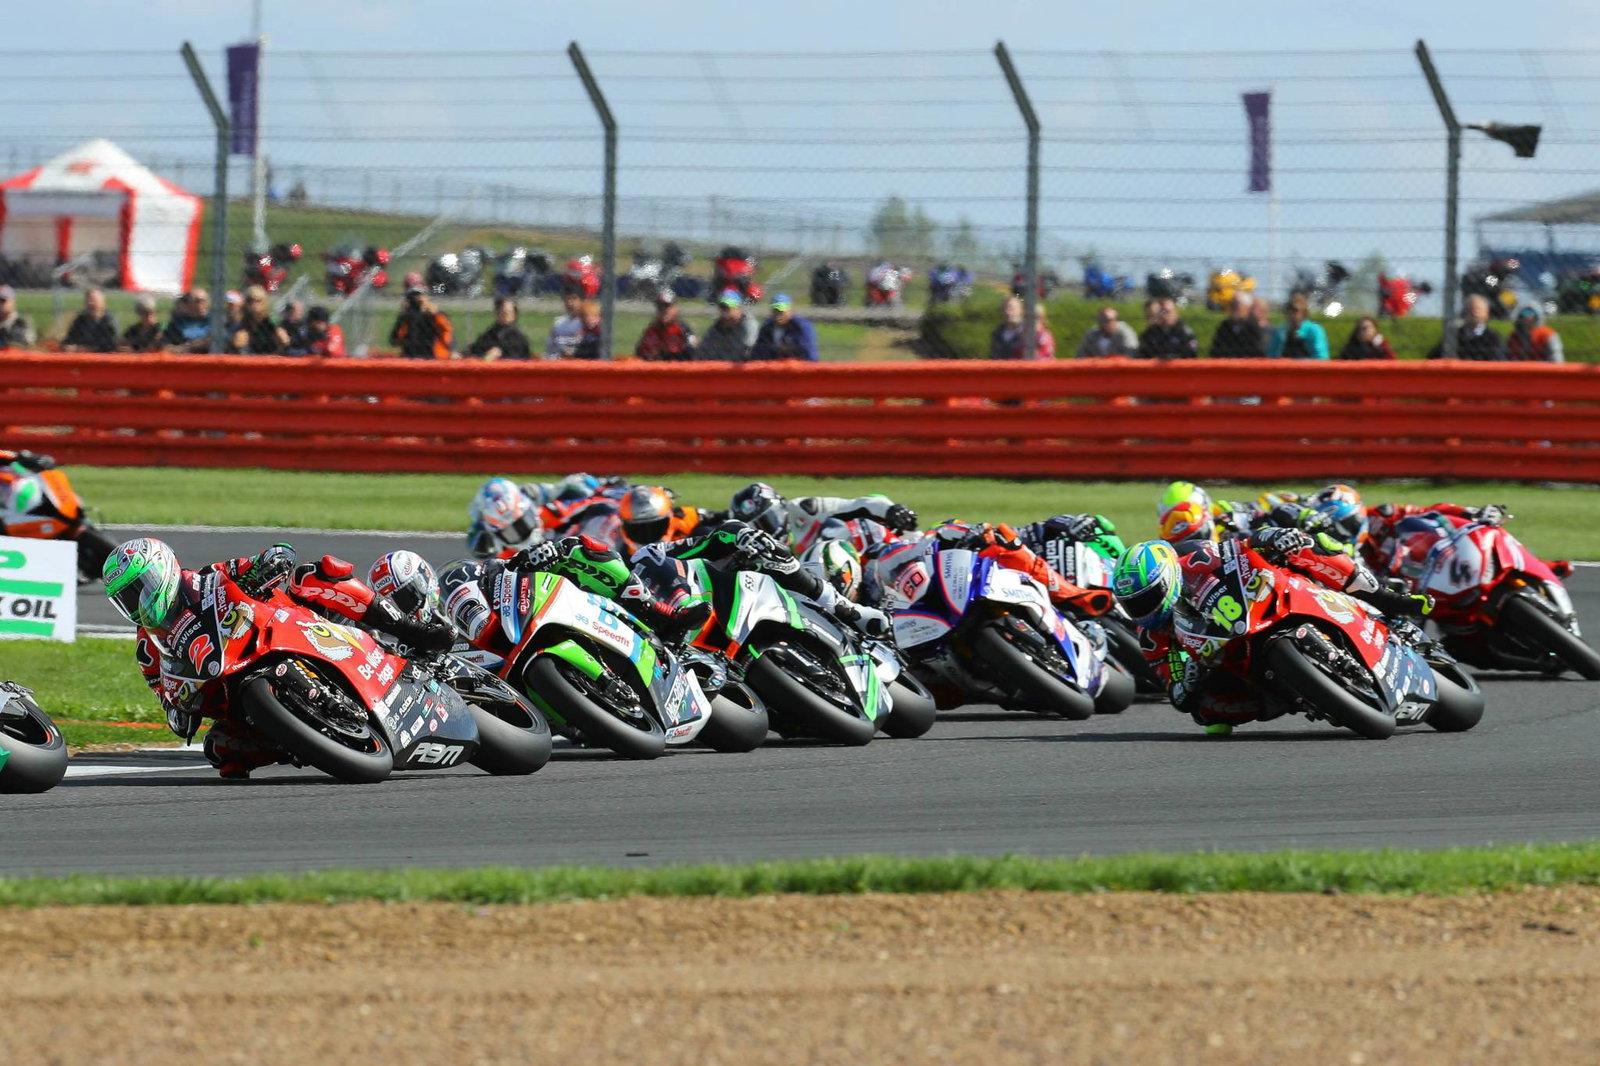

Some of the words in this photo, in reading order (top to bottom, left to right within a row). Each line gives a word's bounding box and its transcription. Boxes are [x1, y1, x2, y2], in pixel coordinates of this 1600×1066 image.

[944, 551, 953, 580] SMITHS
[503, 574, 513, 604] Speedfit
[903, 571, 924, 601] 60
[1206, 585, 1228, 607] Wiser
[11, 598, 57, 619] OIL
[1211, 595, 1243, 632] 18
[171, 611, 192, 635] Bennetts
[180, 621, 202, 644] Wiser
[591, 621, 630, 648] Speedfit
[188, 633, 215, 676] 2
[357, 663, 375, 681] Be
[406, 742, 465, 765] PBM
